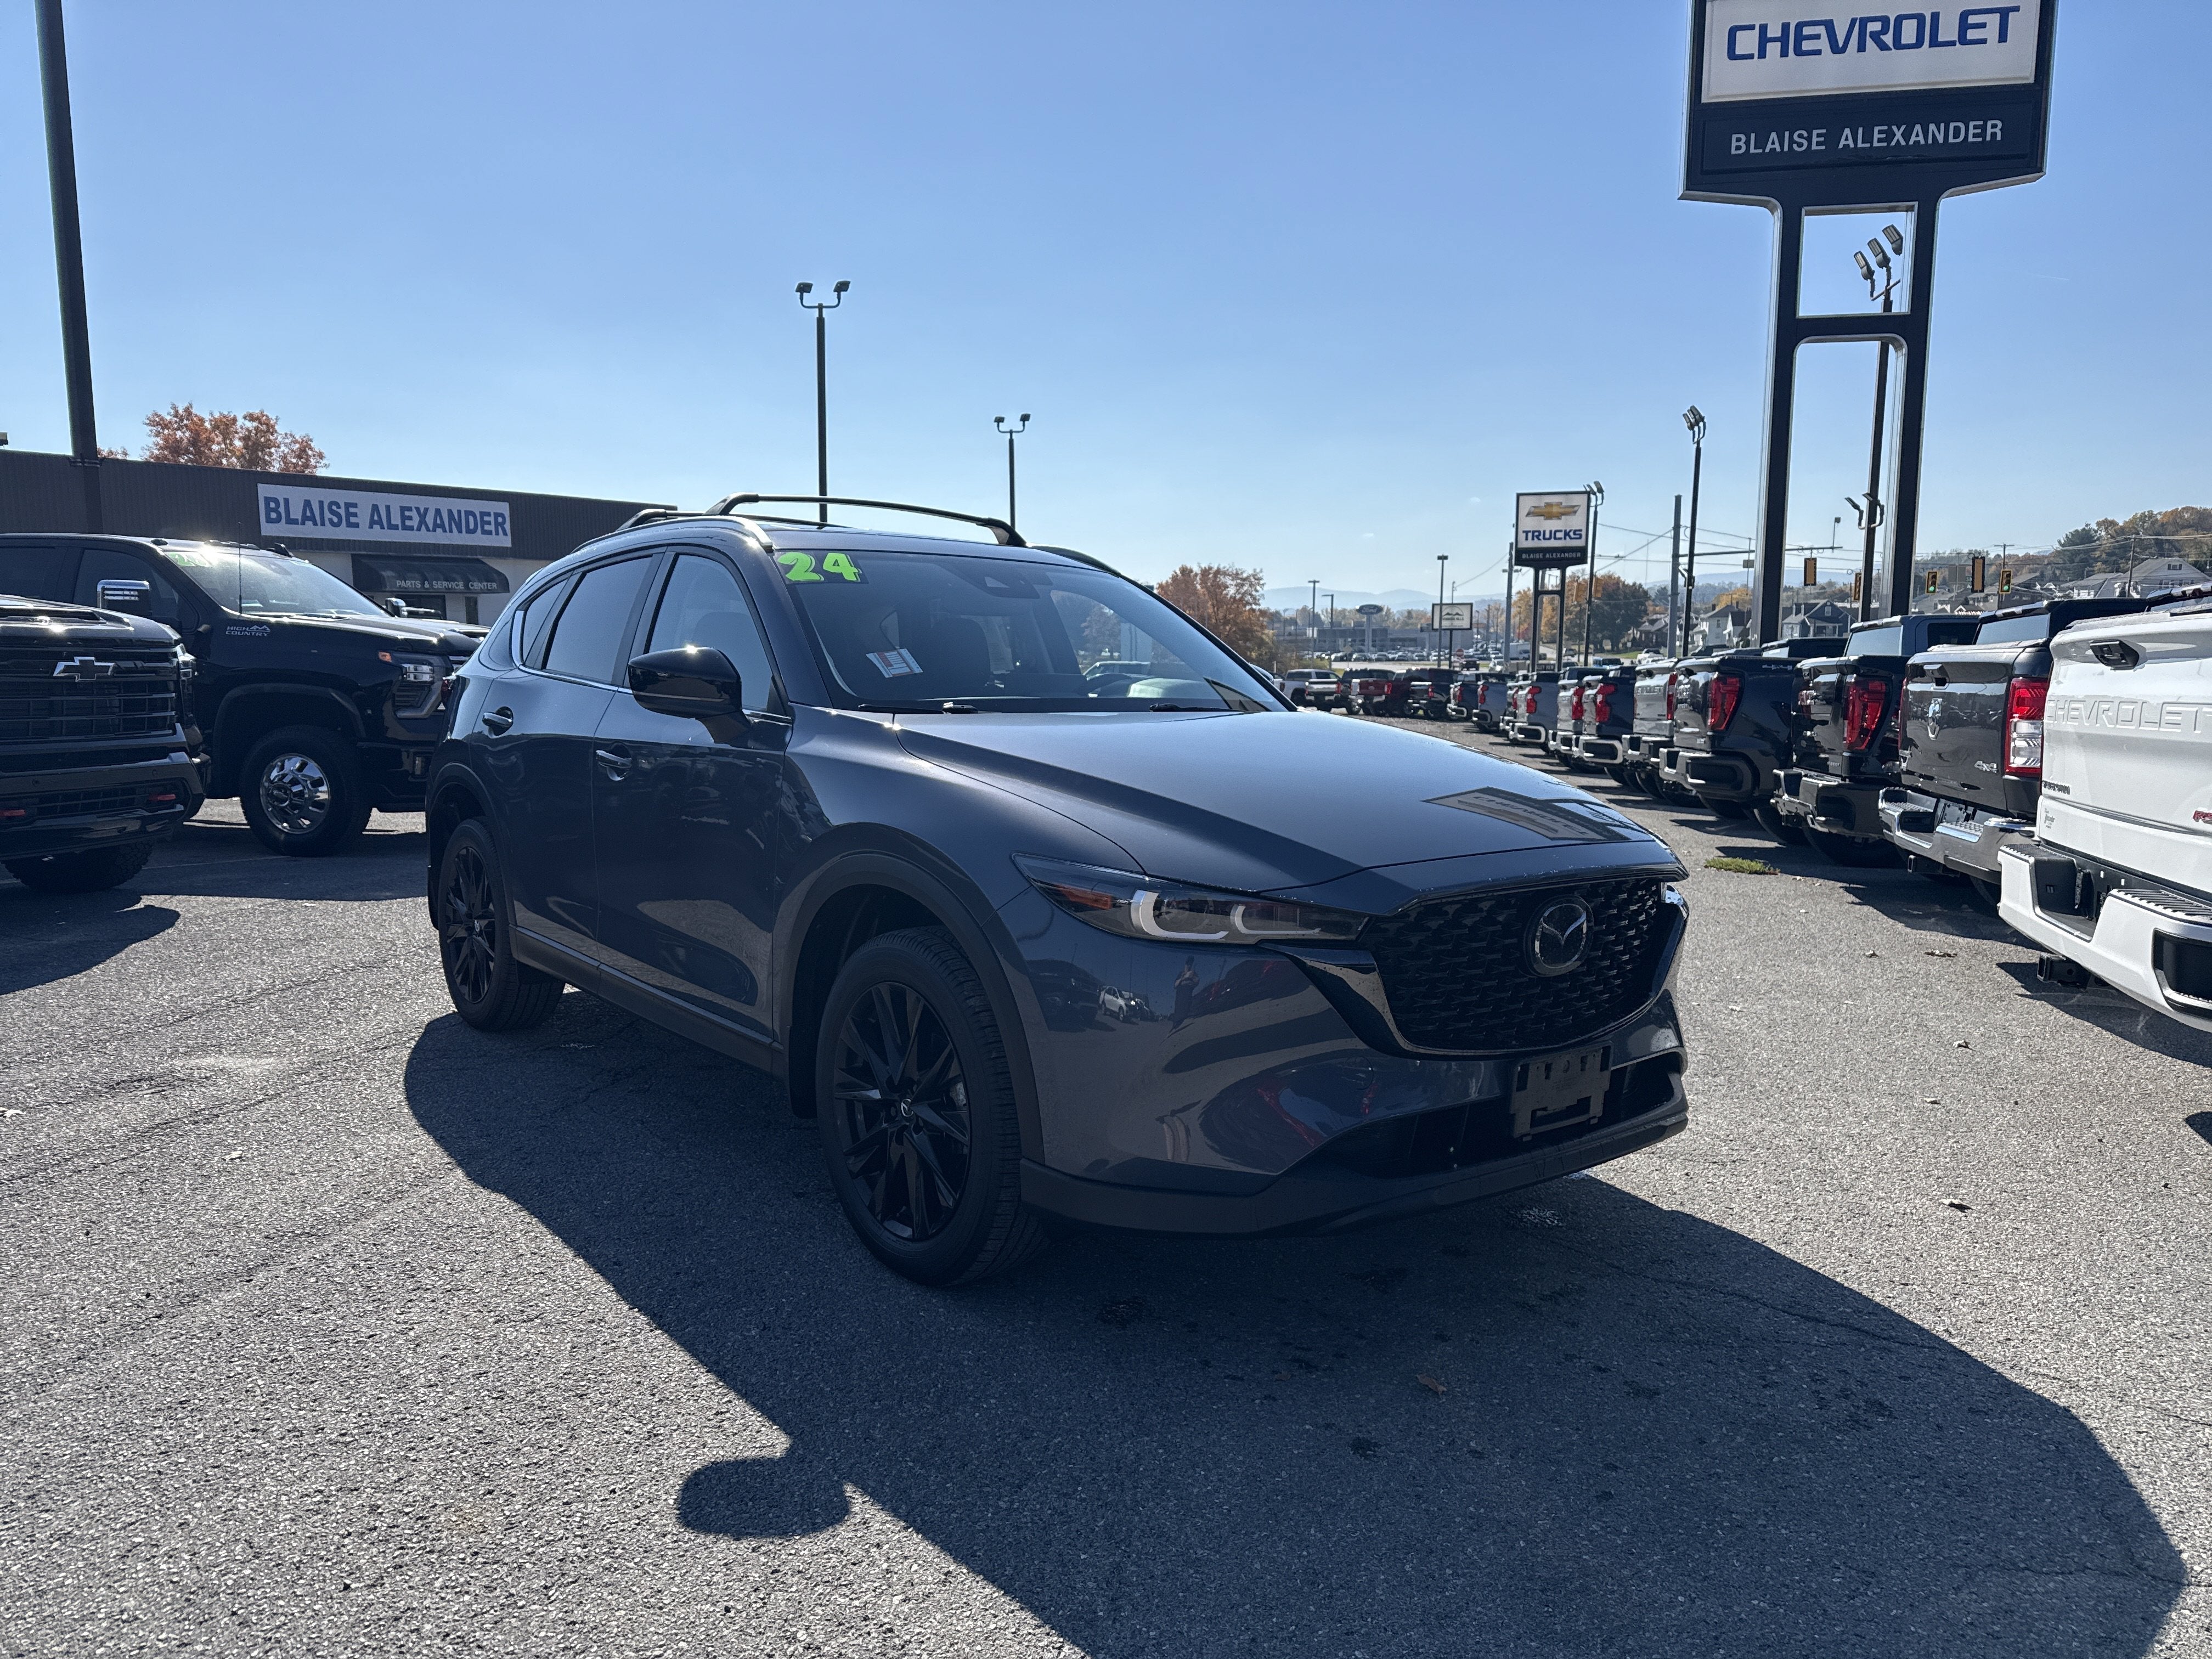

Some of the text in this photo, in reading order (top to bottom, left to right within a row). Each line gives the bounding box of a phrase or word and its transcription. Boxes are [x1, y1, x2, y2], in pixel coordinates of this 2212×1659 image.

[1726, 5, 2021, 60] CHEVROLET
[1730, 119, 2004, 155] BLAISE ALEXANDER
[263, 495, 509, 537] BLAISE ALEXANDER
[1522, 529, 1583, 541] TRUCKS
[777, 551, 862, 582] 24
[396, 580, 421, 588] PARTS
[433, 580, 464, 589] SERVICE
[469, 582, 497, 590] CENTER
[2045, 699, 2212, 733] CHEVROLET
